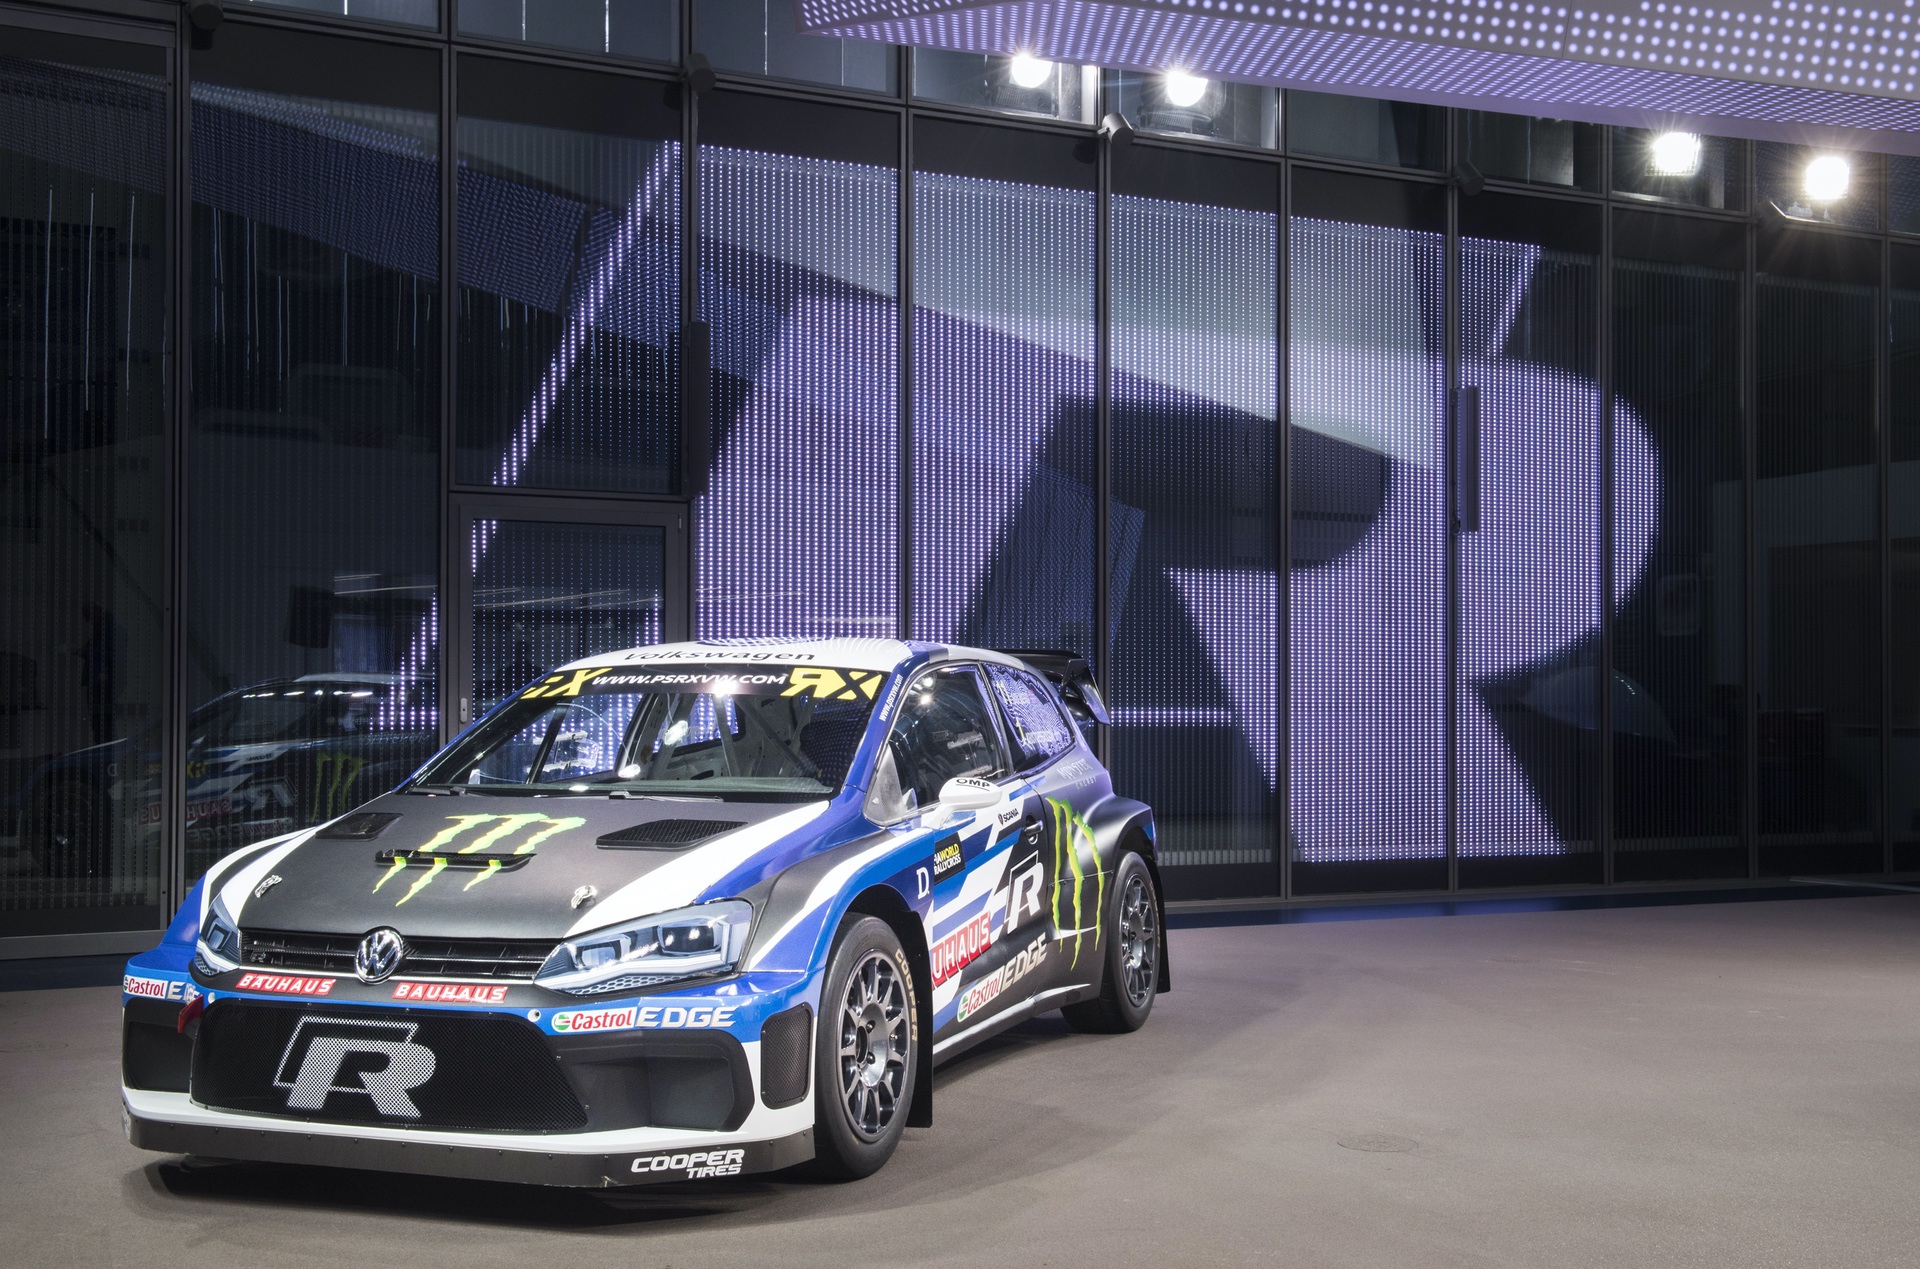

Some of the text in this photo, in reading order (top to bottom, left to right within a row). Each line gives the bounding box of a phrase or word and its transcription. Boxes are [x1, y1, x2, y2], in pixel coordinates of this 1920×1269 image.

[624, 650, 815, 661] Volkswagen
[956, 778, 991, 788] OMP
[1003, 808, 1019, 823] SCANIA
[939, 843, 960, 861] WORLD
[934, 853, 962, 876] RALLYCROSS
[1004, 851, 1044, 934] R
[966, 932, 1047, 1016] Castrol EDGE
[128, 978, 165, 997] Castrol
[238, 977, 332, 994] BAUHAUS
[398, 984, 501, 1001] BAUHAUS
[895, 948, 918, 1042] COOPER
[571, 1006, 739, 1030] Castrol EDGE
[273, 1015, 437, 1119] R
[631, 1149, 745, 1173] COOPER
[686, 1163, 742, 1179] TIRES
